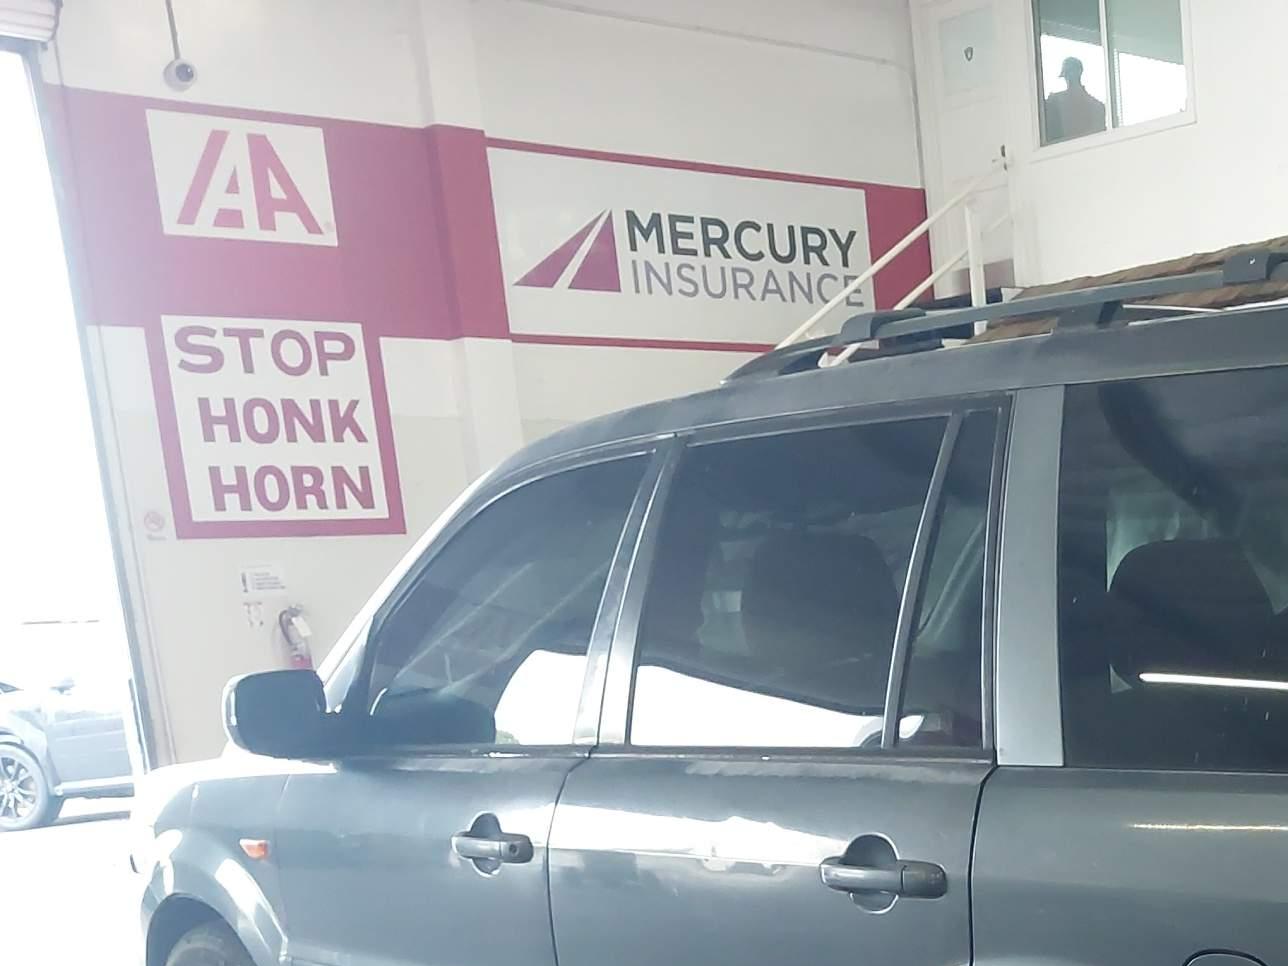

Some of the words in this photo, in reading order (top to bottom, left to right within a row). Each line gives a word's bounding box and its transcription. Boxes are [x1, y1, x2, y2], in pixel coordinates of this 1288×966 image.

[625, 209, 857, 268] MERCURY
[631, 259, 865, 307] INSURANCE
[174, 325, 356, 376] STOP
[197, 397, 369, 444] HONK
[208, 465, 376, 512] HORN
